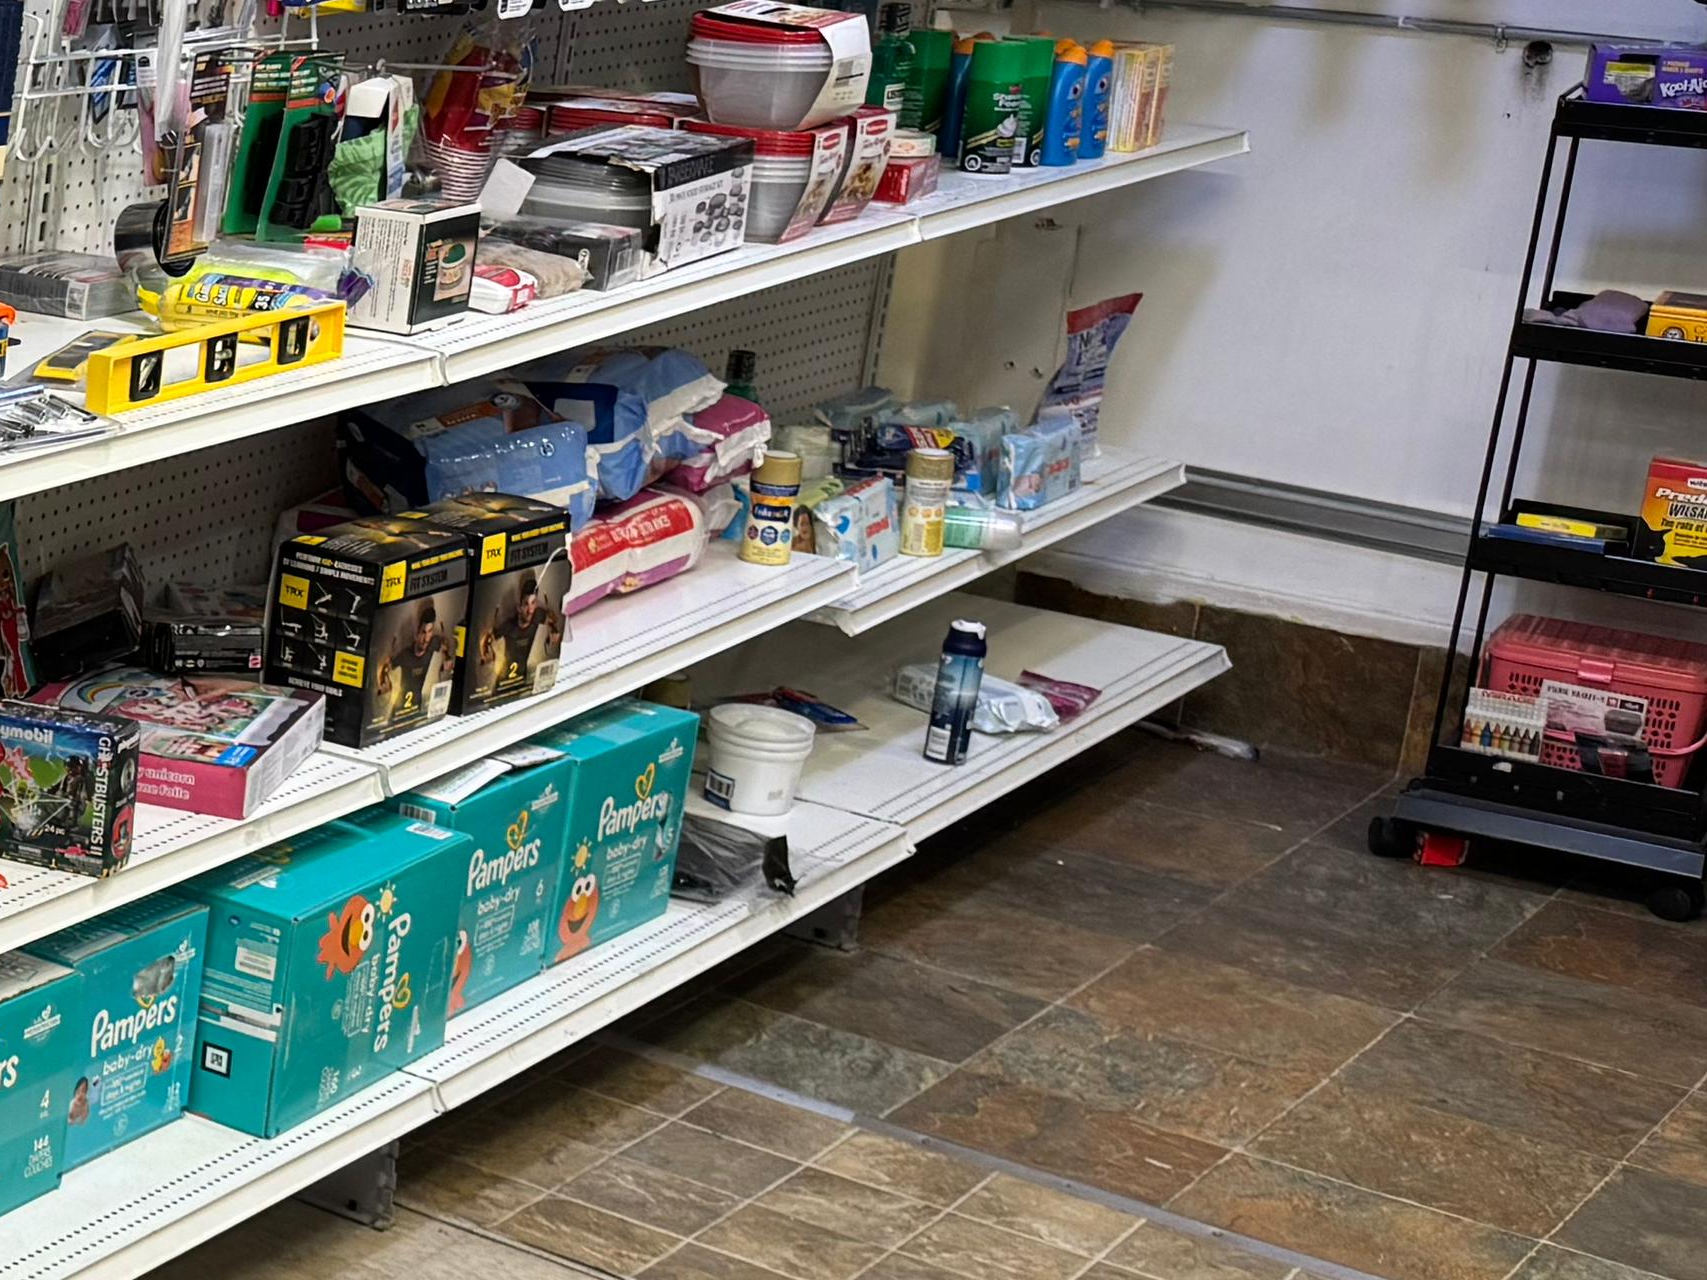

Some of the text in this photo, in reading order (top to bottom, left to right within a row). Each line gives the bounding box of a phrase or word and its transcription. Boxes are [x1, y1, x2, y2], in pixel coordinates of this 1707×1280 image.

[486, 546, 503, 560] TRX
[508, 661, 518, 678] 2
[403, 691, 413, 708] 2
[597, 792, 669, 843] Pampers
[606, 833, 648, 861] baby-dry
[467, 838, 541, 897] Pampers
[476, 886, 521, 916] baby-dry
[361, 952, 382, 1034] baby-dry
[373, 911, 412, 1054] Pampers
[90, 995, 178, 1059] Pampers
[102, 1043, 154, 1077] baby-dry
[40, 1089, 52, 1109] 4
[34, 1135, 51, 1153] 144
